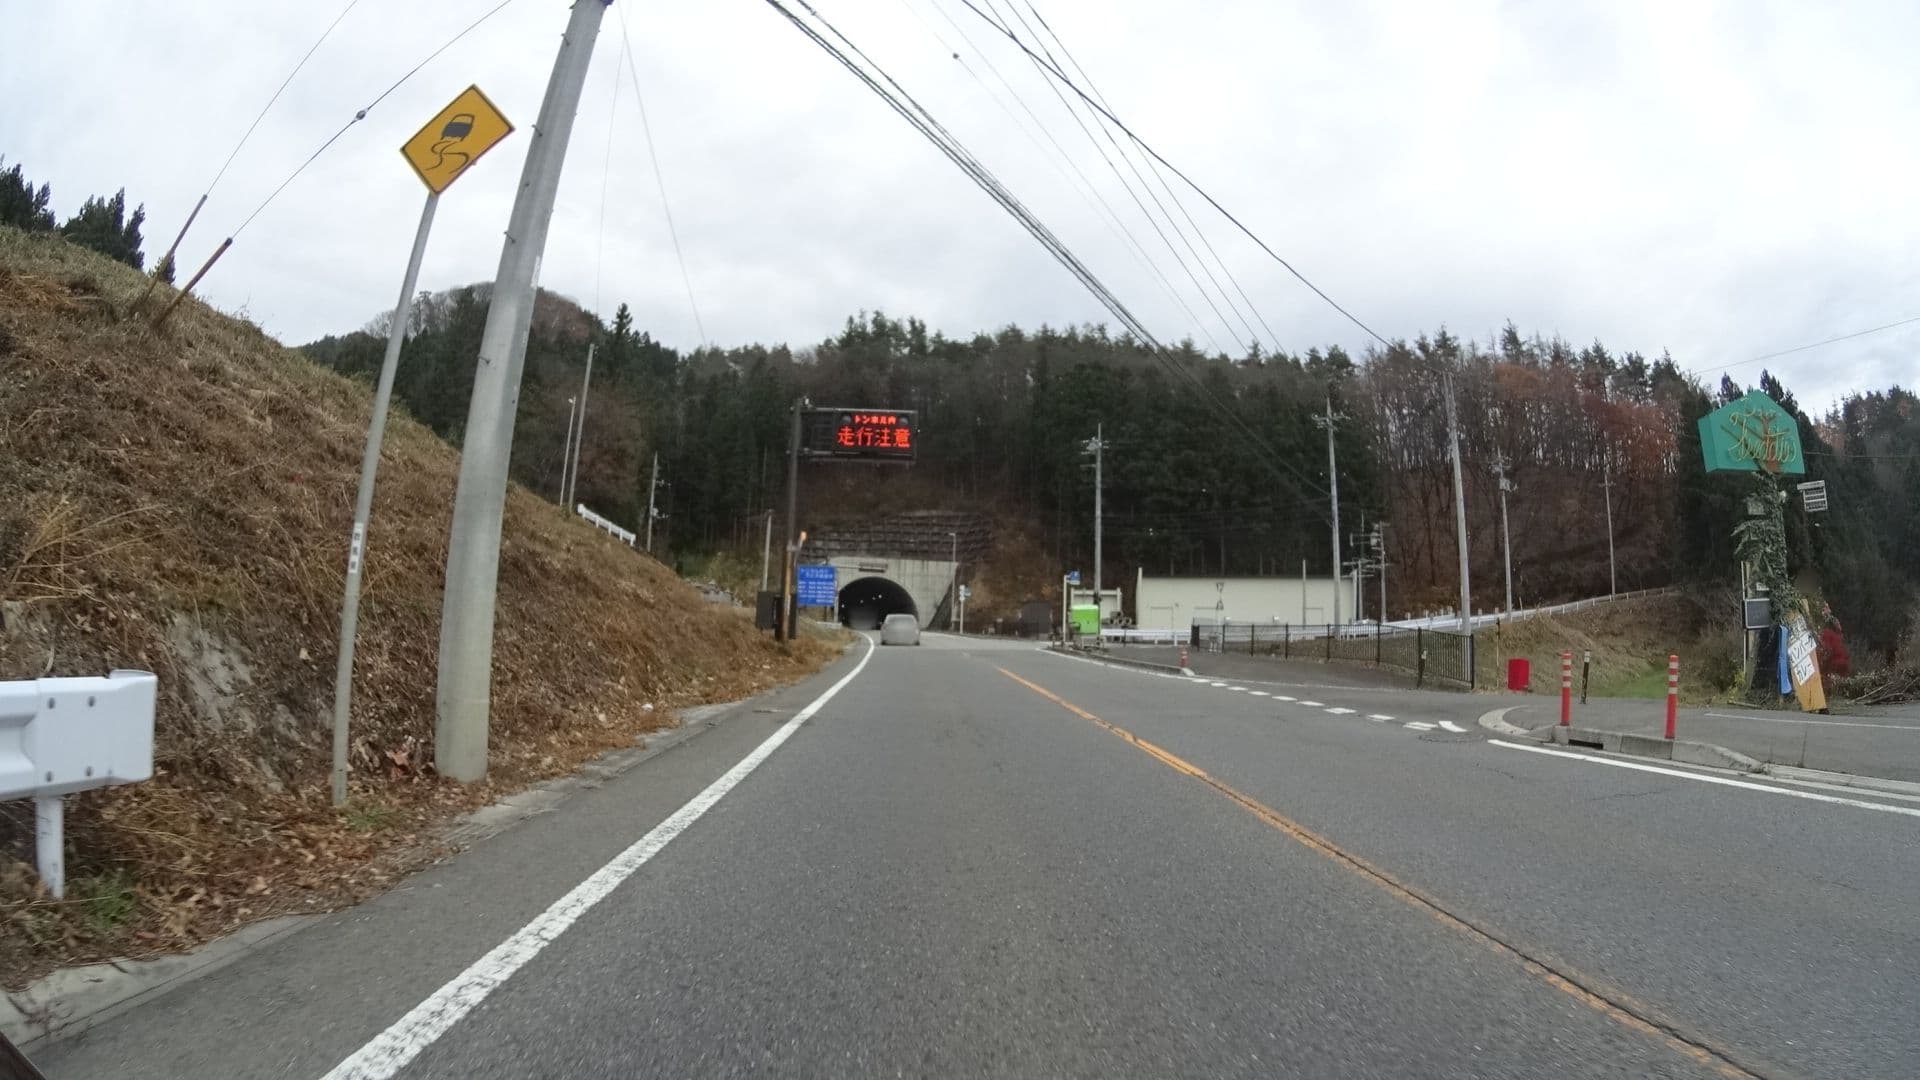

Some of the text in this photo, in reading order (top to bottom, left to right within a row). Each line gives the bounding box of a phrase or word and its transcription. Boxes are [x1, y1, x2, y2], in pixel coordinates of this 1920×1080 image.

[837, 426, 911, 448] 走行注意
[1797, 664, 1811, 681] カレー
